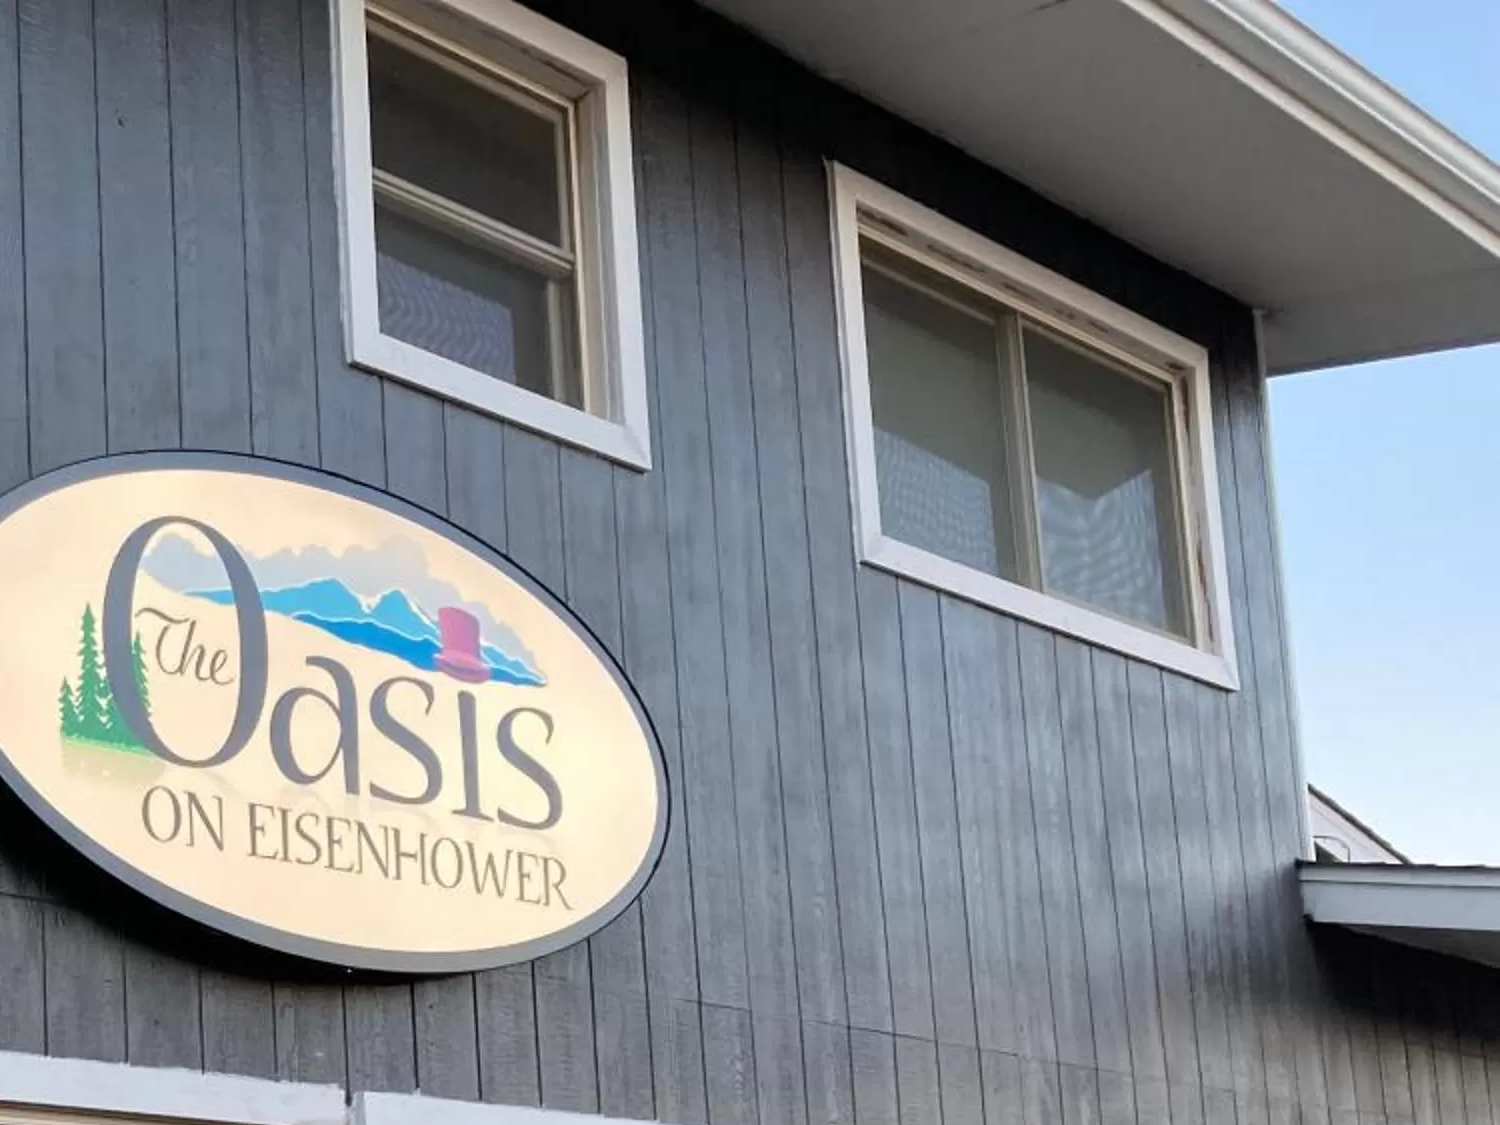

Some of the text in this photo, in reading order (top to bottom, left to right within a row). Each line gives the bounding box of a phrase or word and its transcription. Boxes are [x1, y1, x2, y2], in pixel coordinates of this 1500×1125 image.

[133, 607, 235, 685] The
[143, 787, 574, 910] ON EISENHOWER
